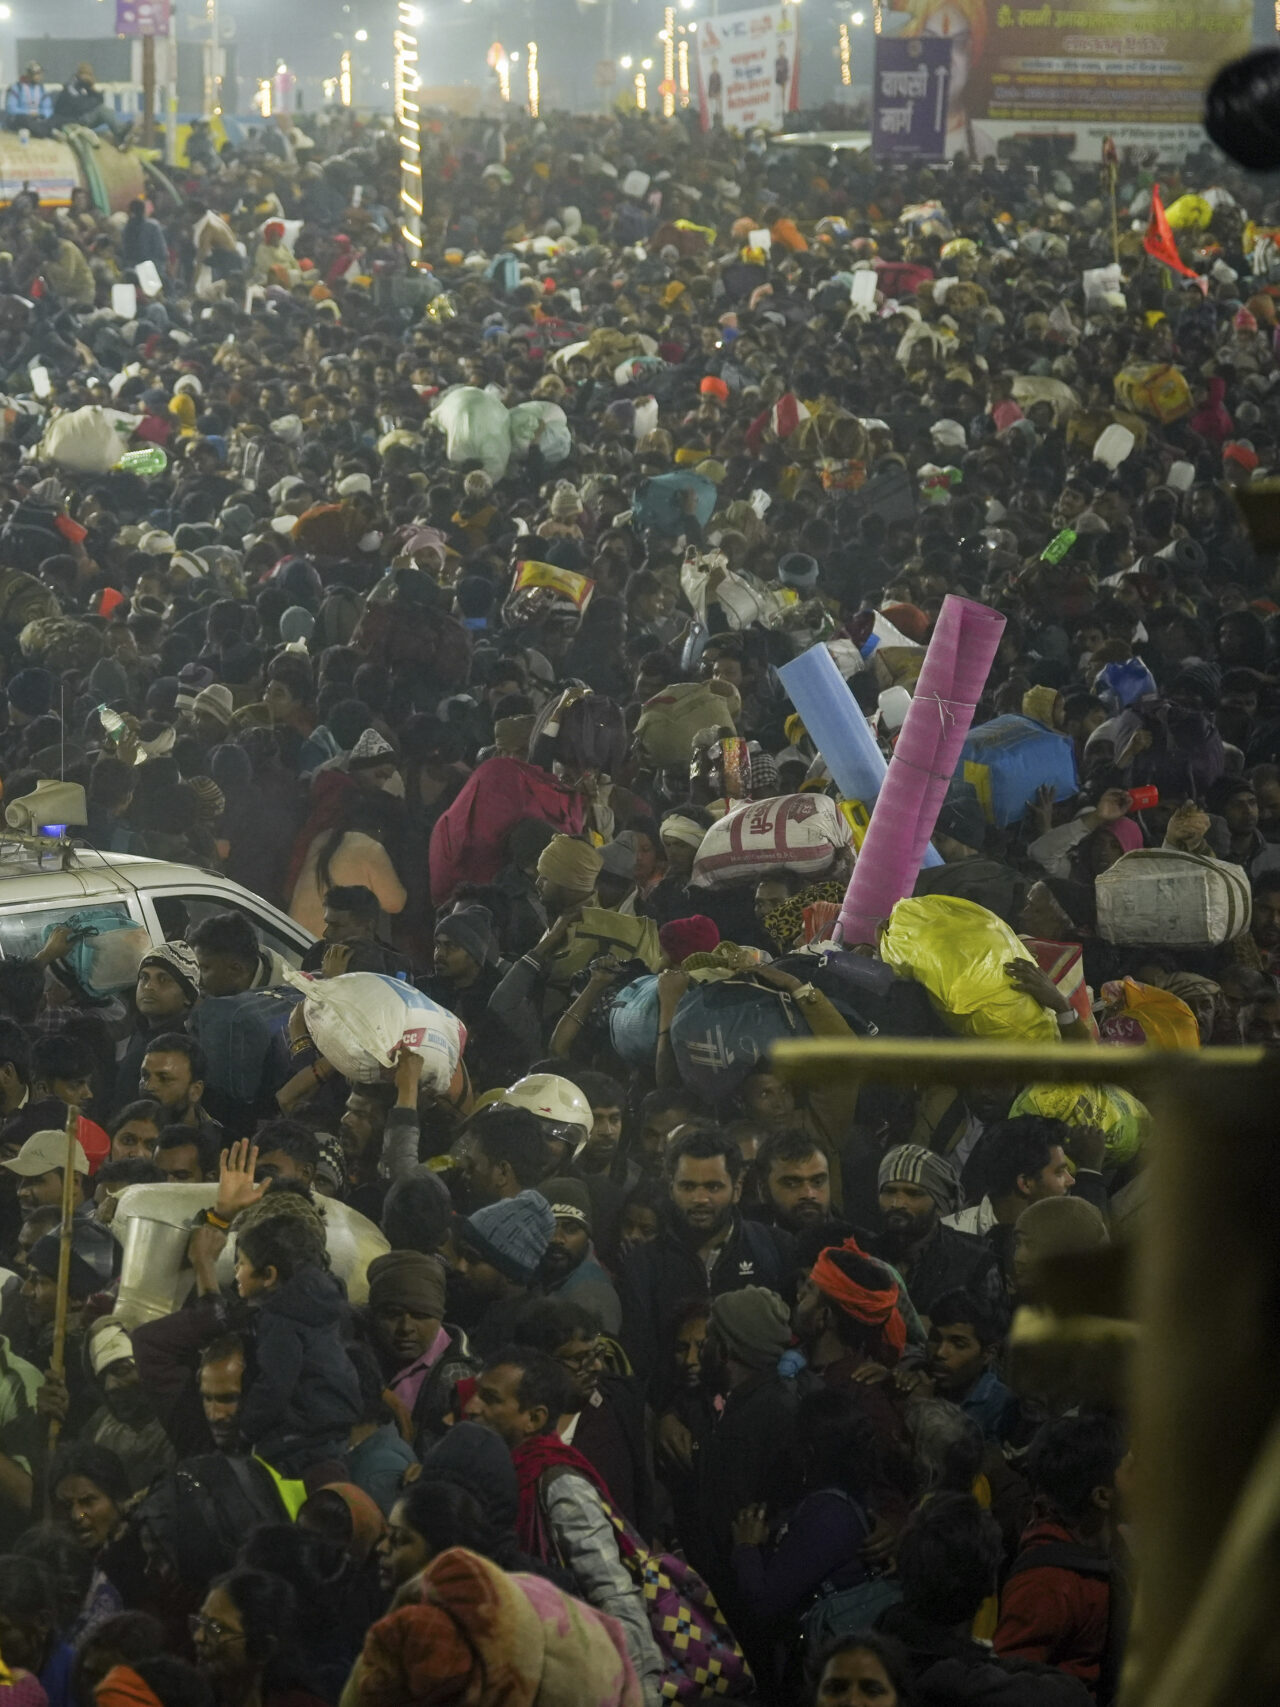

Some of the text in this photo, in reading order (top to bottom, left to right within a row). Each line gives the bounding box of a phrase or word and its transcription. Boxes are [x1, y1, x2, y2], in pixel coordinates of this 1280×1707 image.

[880, 63, 929, 98] वापसी
[879, 100, 914, 134] मार्ग
[551, 1203, 585, 1218] NIKE
